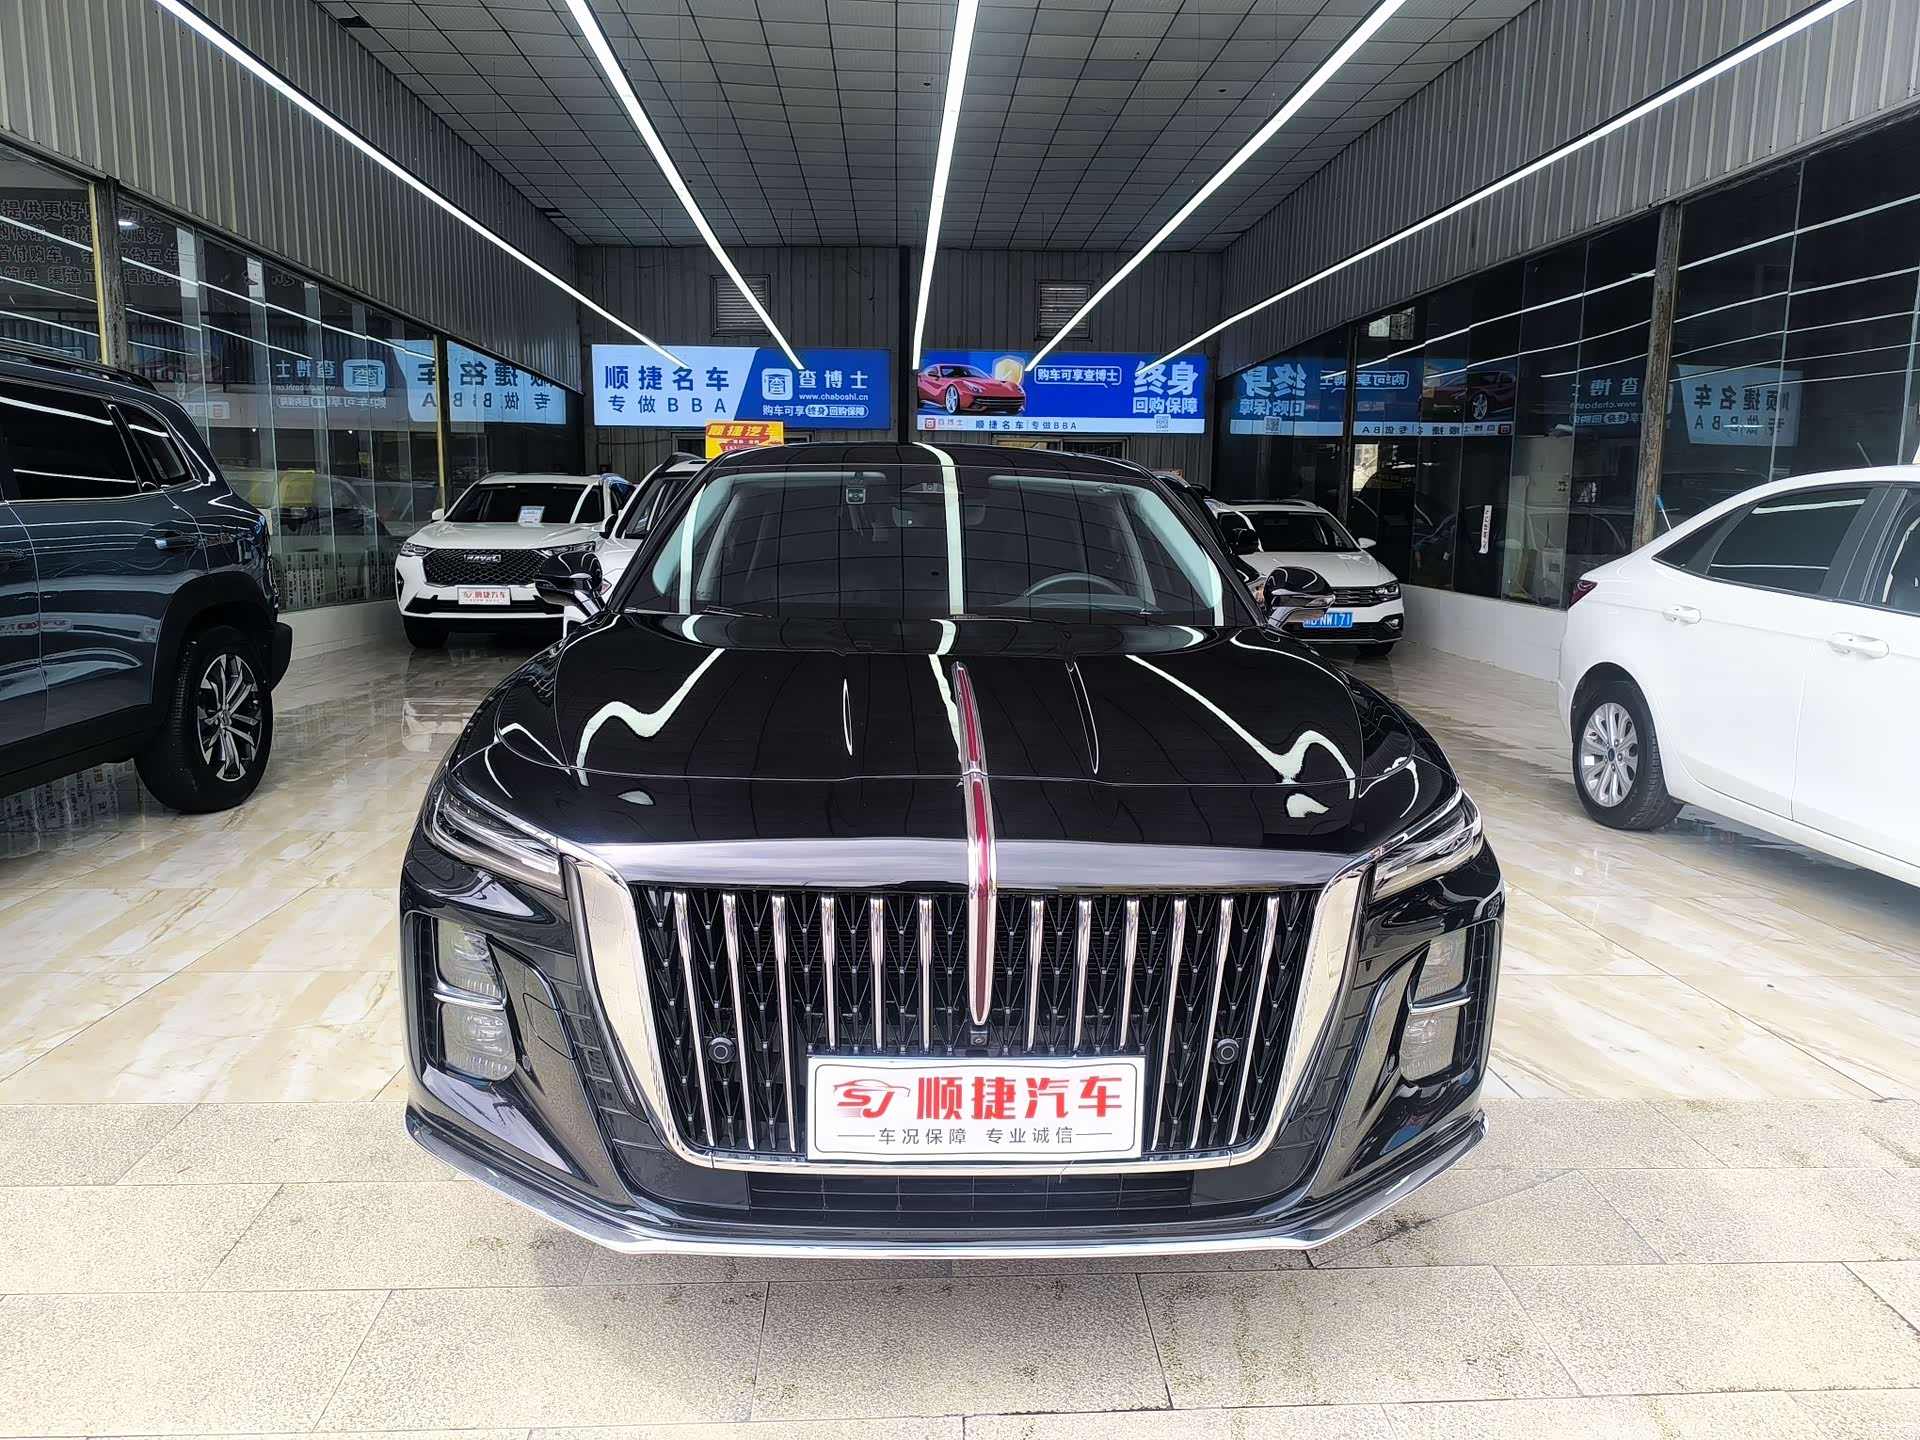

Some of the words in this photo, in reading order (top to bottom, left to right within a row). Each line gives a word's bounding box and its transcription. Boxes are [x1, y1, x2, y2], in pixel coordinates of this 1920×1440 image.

[604, 365, 730, 391] 顺捷名车
[798, 369, 869, 390] 查博士
[1037, 368, 1119, 383] 购车可享查博士
[1133, 360, 1200, 397] 终身
[798, 392, 870, 402] www.chaboshi.cn
[1132, 396, 1199, 415] 回购保障
[975, 419, 1025, 431] 顺捷名车
[466, 554, 499, 563] HAVAL
[916, 1075, 1123, 1120] 顺捷汽车
[877, 1127, 968, 1145] 车况保障
[985, 1126, 1074, 1144] 专业诚信
